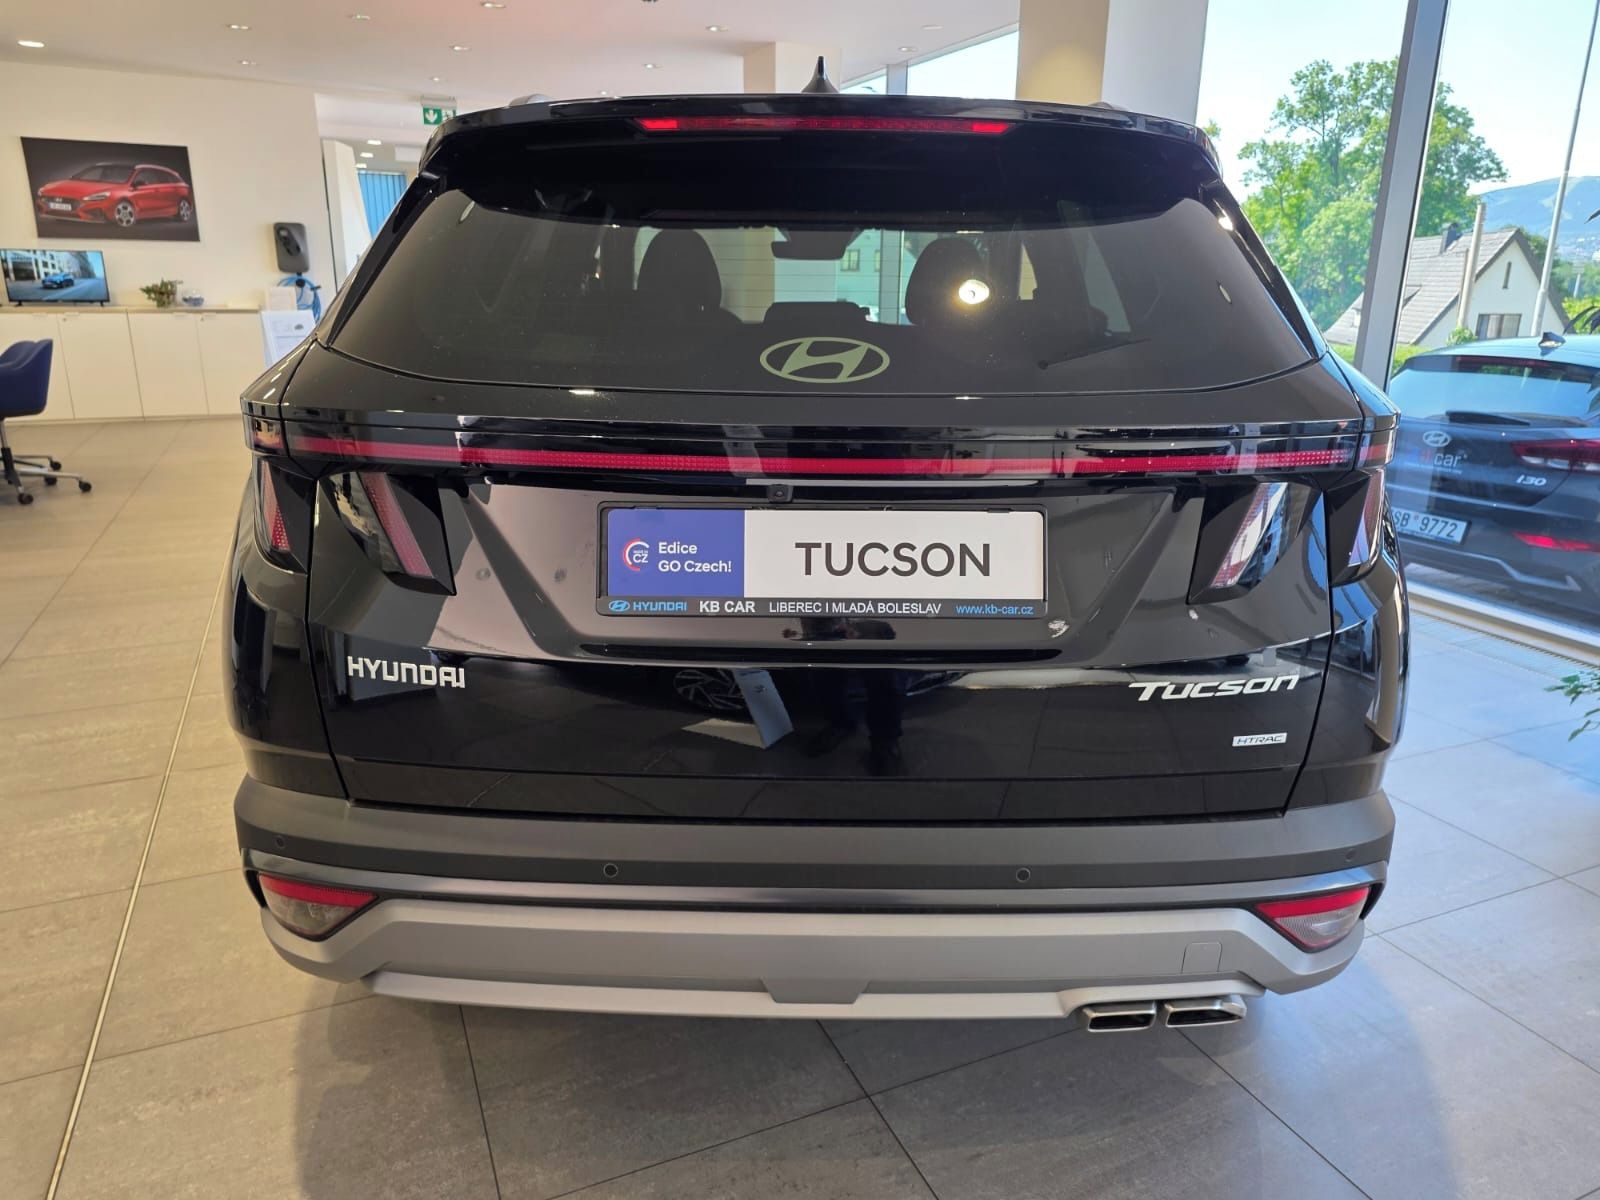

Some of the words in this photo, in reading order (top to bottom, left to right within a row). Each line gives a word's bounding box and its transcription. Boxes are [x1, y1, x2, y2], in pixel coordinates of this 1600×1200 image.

[1419, 516, 1458, 538] 9772
[658, 541, 698, 554] Edice
[632, 553, 649, 563] CZ
[795, 541, 990, 577] TUCSON
[658, 560, 681, 572] GO
[684, 560, 732, 573] Czech!
[633, 601, 687, 612] HYUNDAI
[699, 600, 720, 613] KB
[724, 600, 756, 613] CAR
[769, 601, 822, 613] LIBEREC
[832, 600, 875, 614] MLADÁ
[878, 602, 942, 614] BOLESLAV
[955, 604, 1034, 615] www.kb-car.cz
[347, 655, 466, 688] HYUNDAI
[1128, 674, 1300, 701] TUCSON
[1236, 735, 1284, 745] HTRAC
